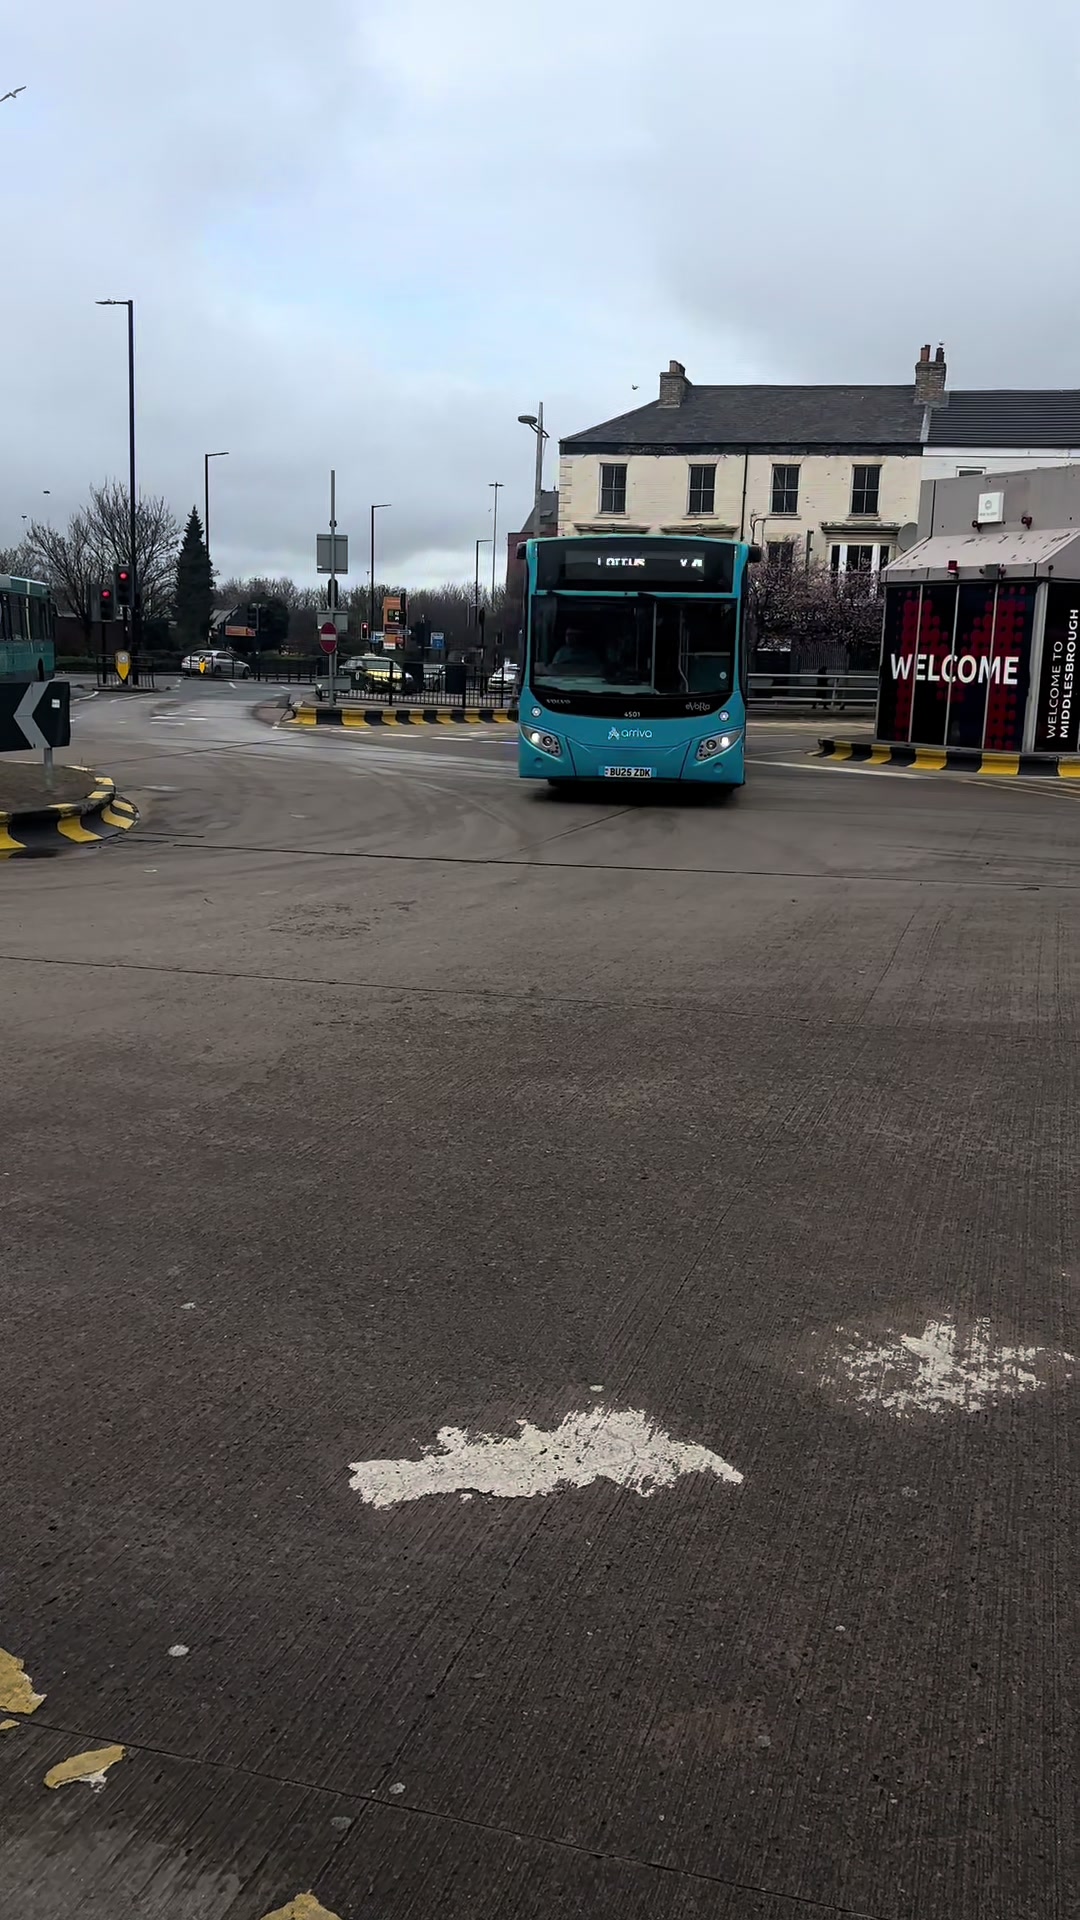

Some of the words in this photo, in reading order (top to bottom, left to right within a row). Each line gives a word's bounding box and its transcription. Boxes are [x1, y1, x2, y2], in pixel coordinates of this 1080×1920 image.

[1053, 641, 1063, 661] TO
[890, 653, 1019, 685] WELCOME
[1060, 609, 1079, 738] MIDDLESBROUGH
[1046, 665, 1061, 739] WELCOME
[621, 728, 652, 738] arriva
[610, 767, 632, 776] BU25
[634, 768, 651, 777] ZDK
